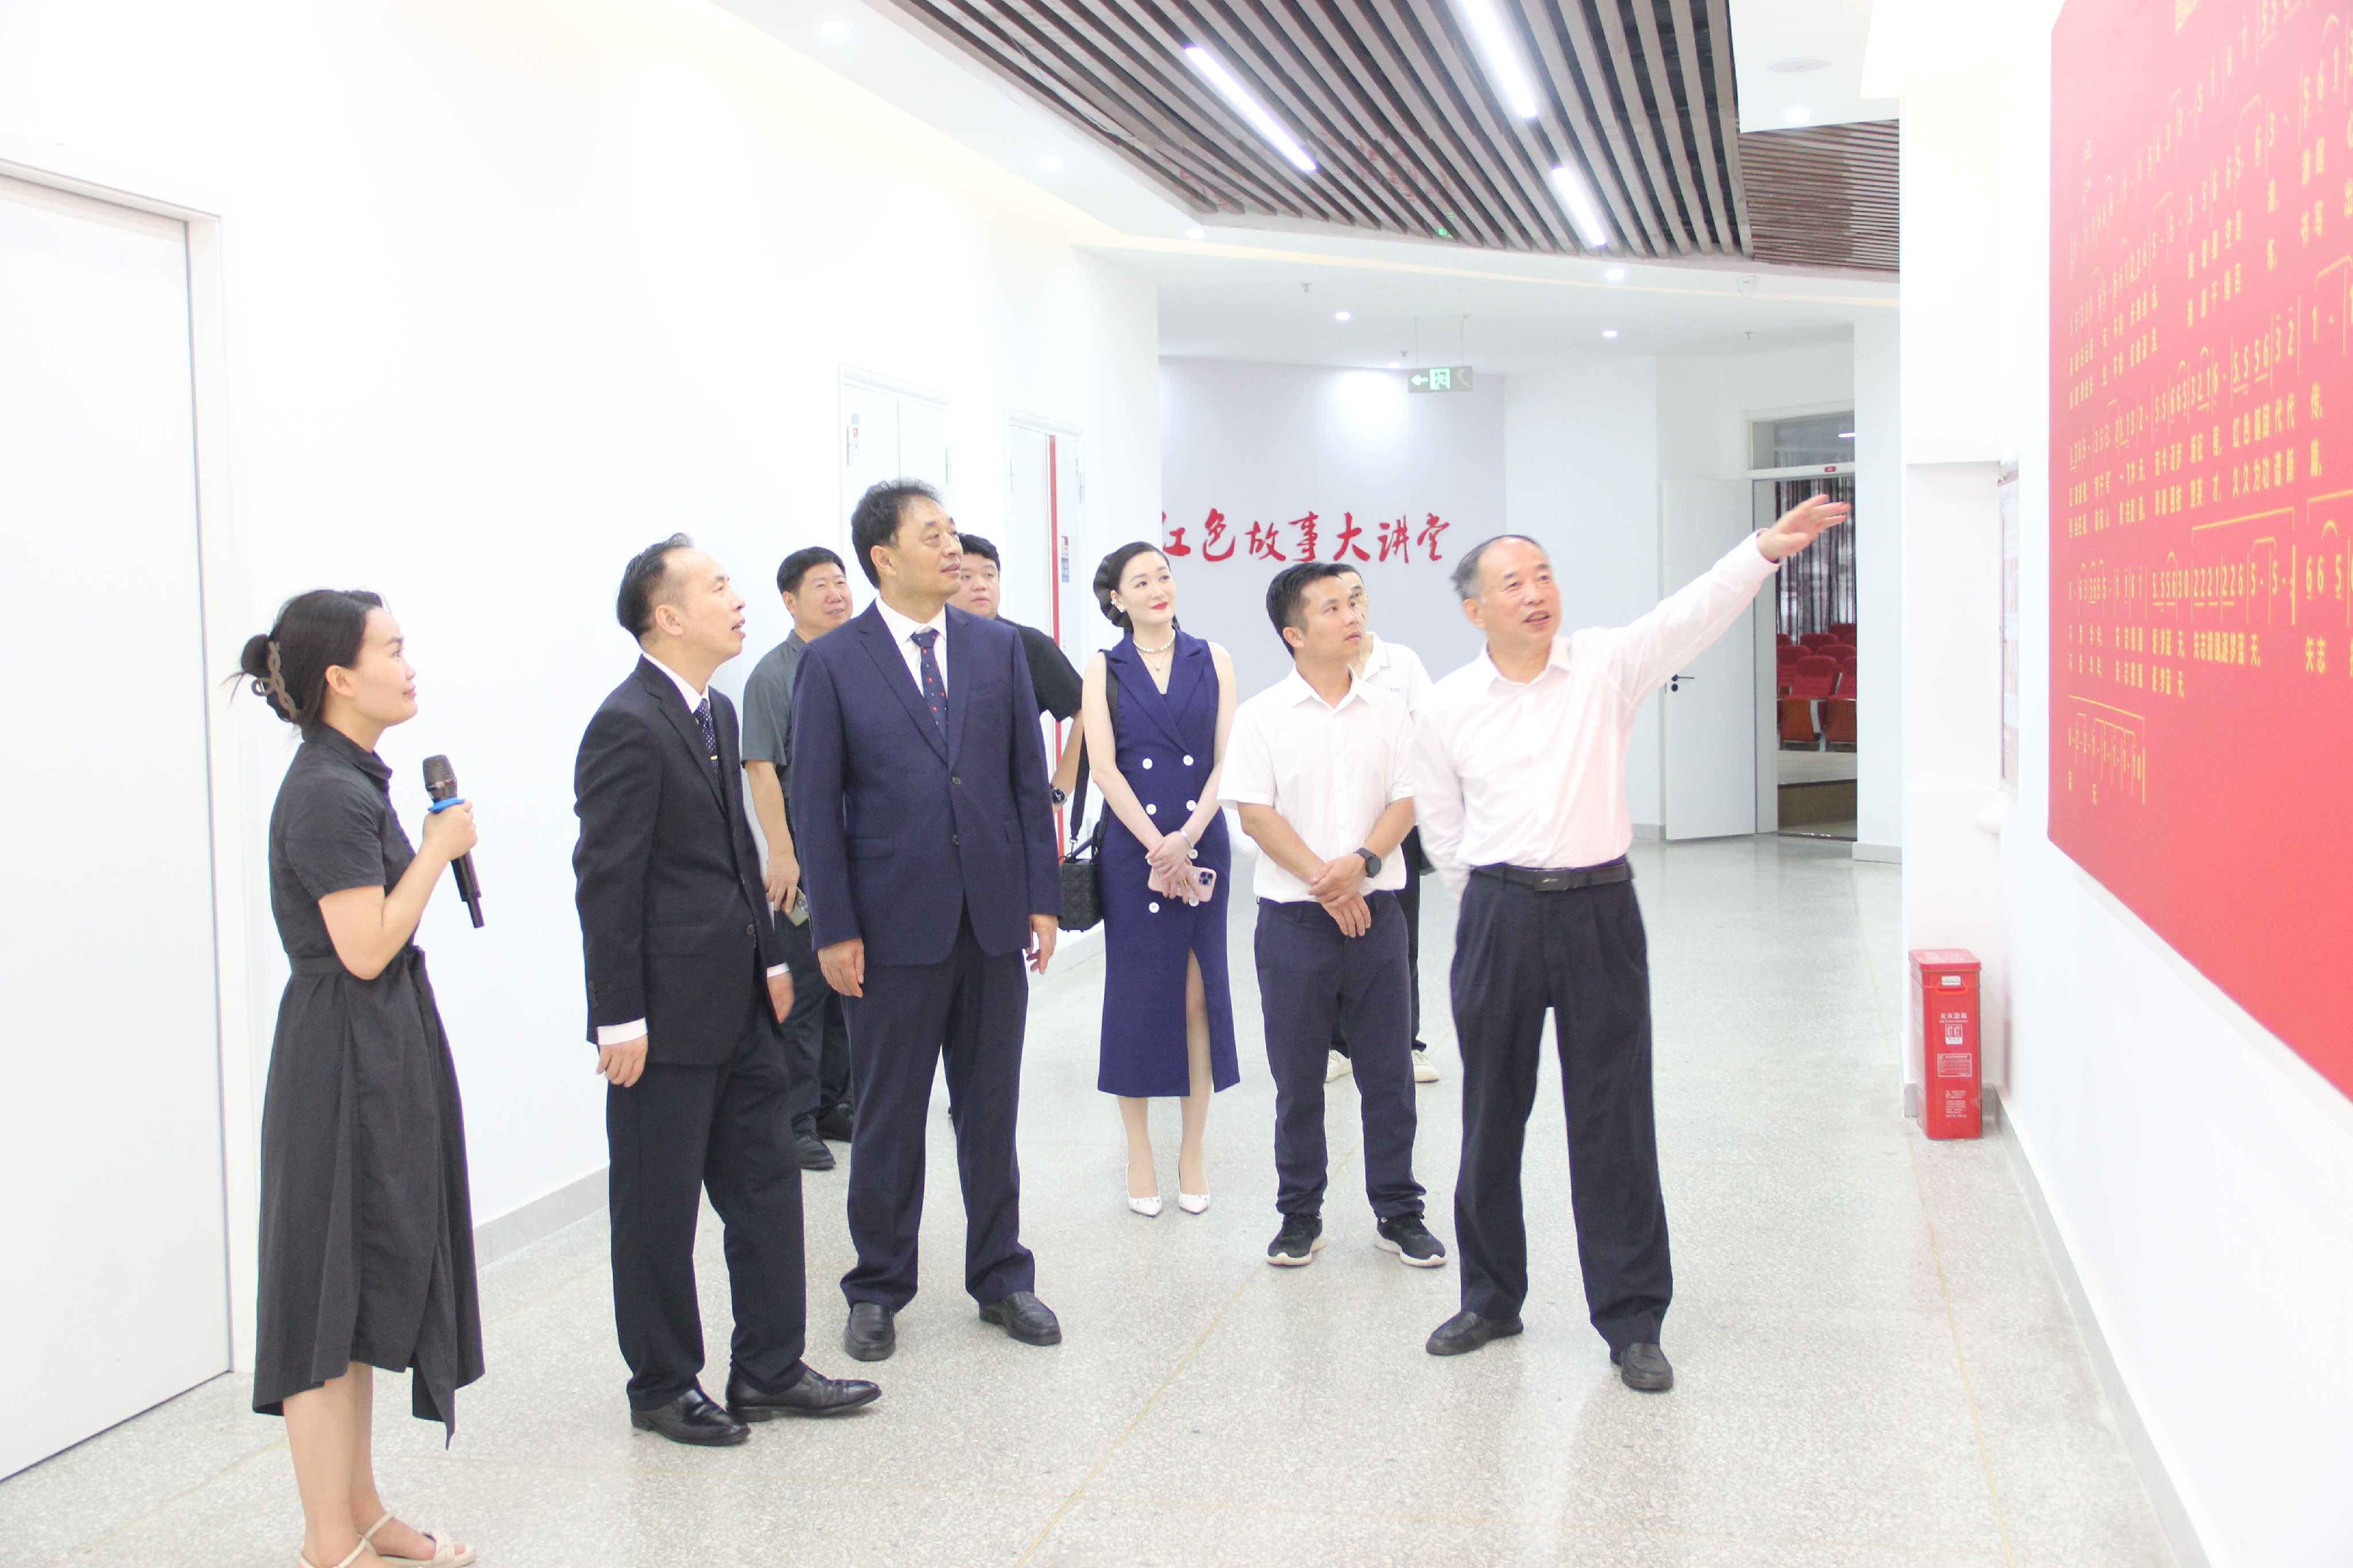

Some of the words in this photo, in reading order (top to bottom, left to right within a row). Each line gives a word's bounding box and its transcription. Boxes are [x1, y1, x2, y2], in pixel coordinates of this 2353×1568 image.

[1162, 508, 1449, 563] 红色故事大讲堂
